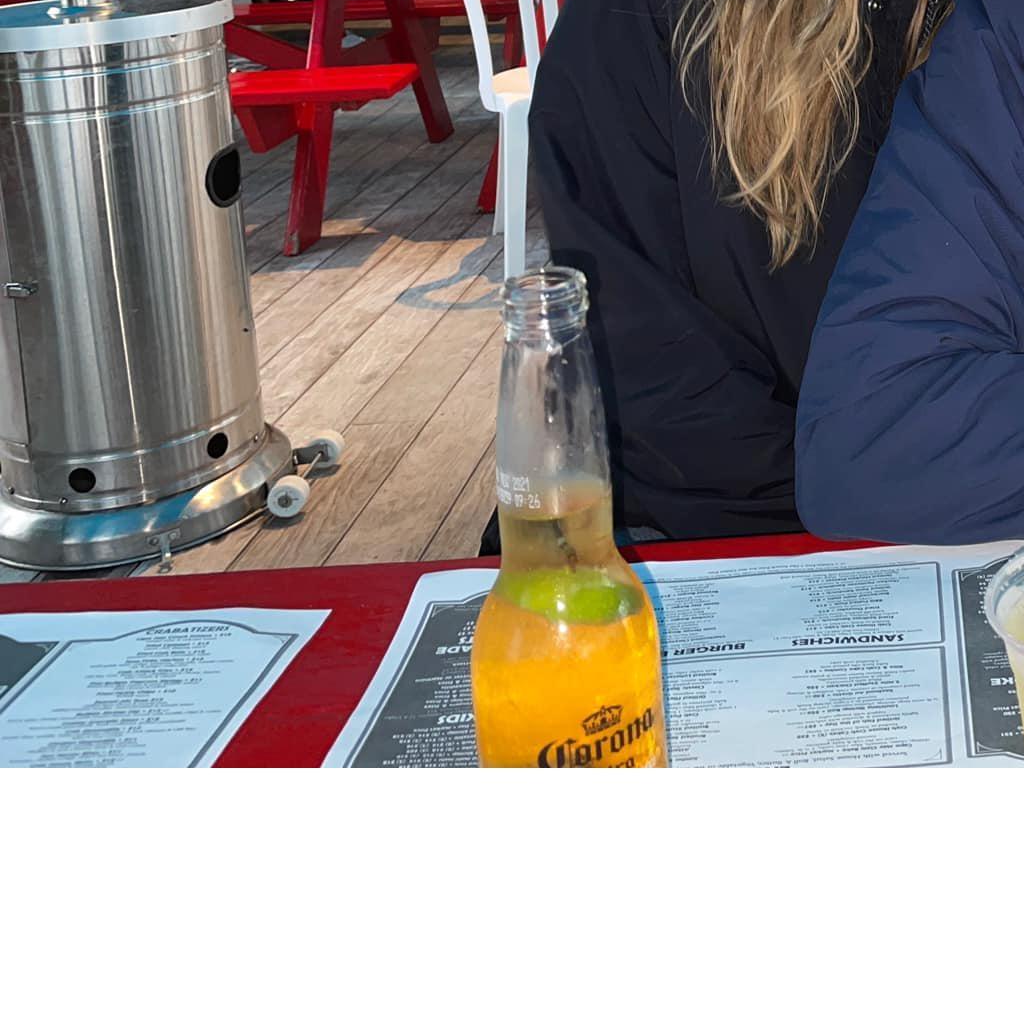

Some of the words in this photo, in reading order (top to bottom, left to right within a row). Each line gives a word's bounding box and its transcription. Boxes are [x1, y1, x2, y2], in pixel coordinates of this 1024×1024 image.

[146, 625, 230, 636] CRABATIZERS
[791, 633, 904, 647] SANDWICHES
[435, 645, 473, 655] ADE
[673, 643, 746, 656] BURGER
[990, 677, 1014, 686] KE
[538, 707, 652, 768] Corona
